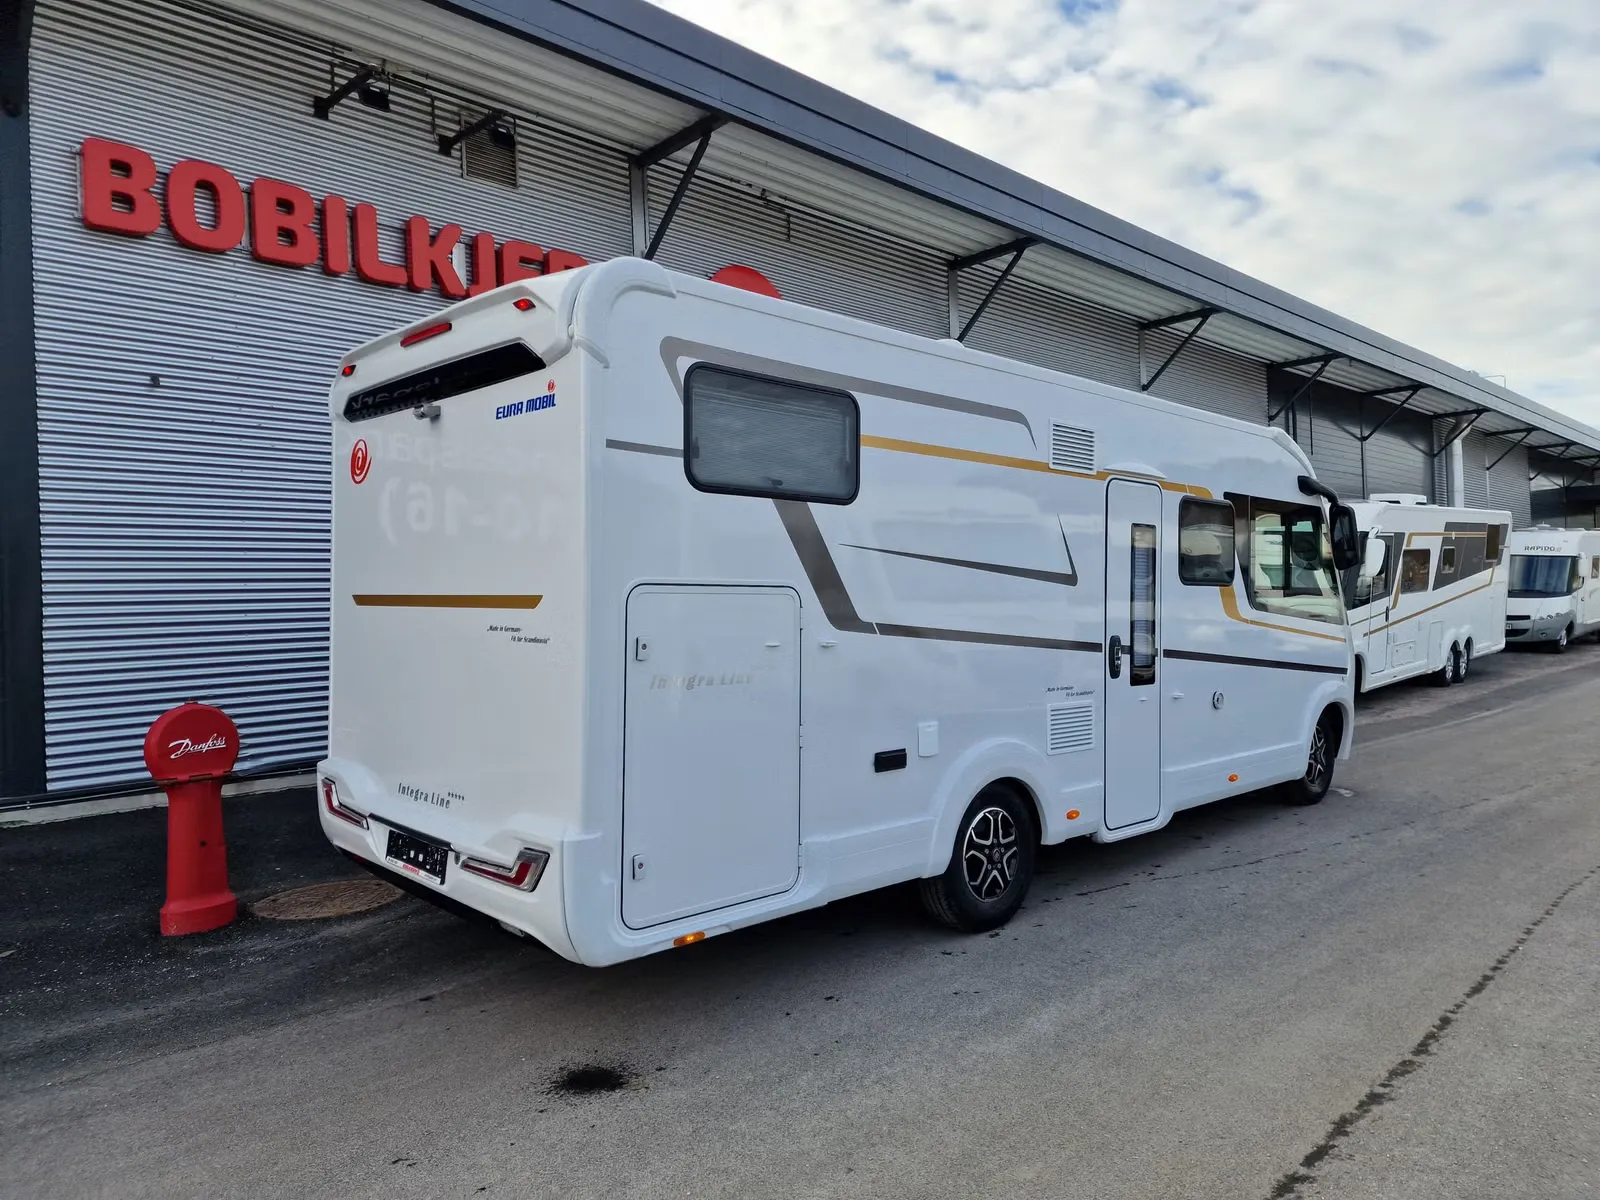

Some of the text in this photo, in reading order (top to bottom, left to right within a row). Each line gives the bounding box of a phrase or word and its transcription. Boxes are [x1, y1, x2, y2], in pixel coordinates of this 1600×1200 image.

[495, 393, 557, 420] EURA MOBIL
[168, 733, 227, 759] Danfoss
[398, 782, 451, 809] Integra Line
